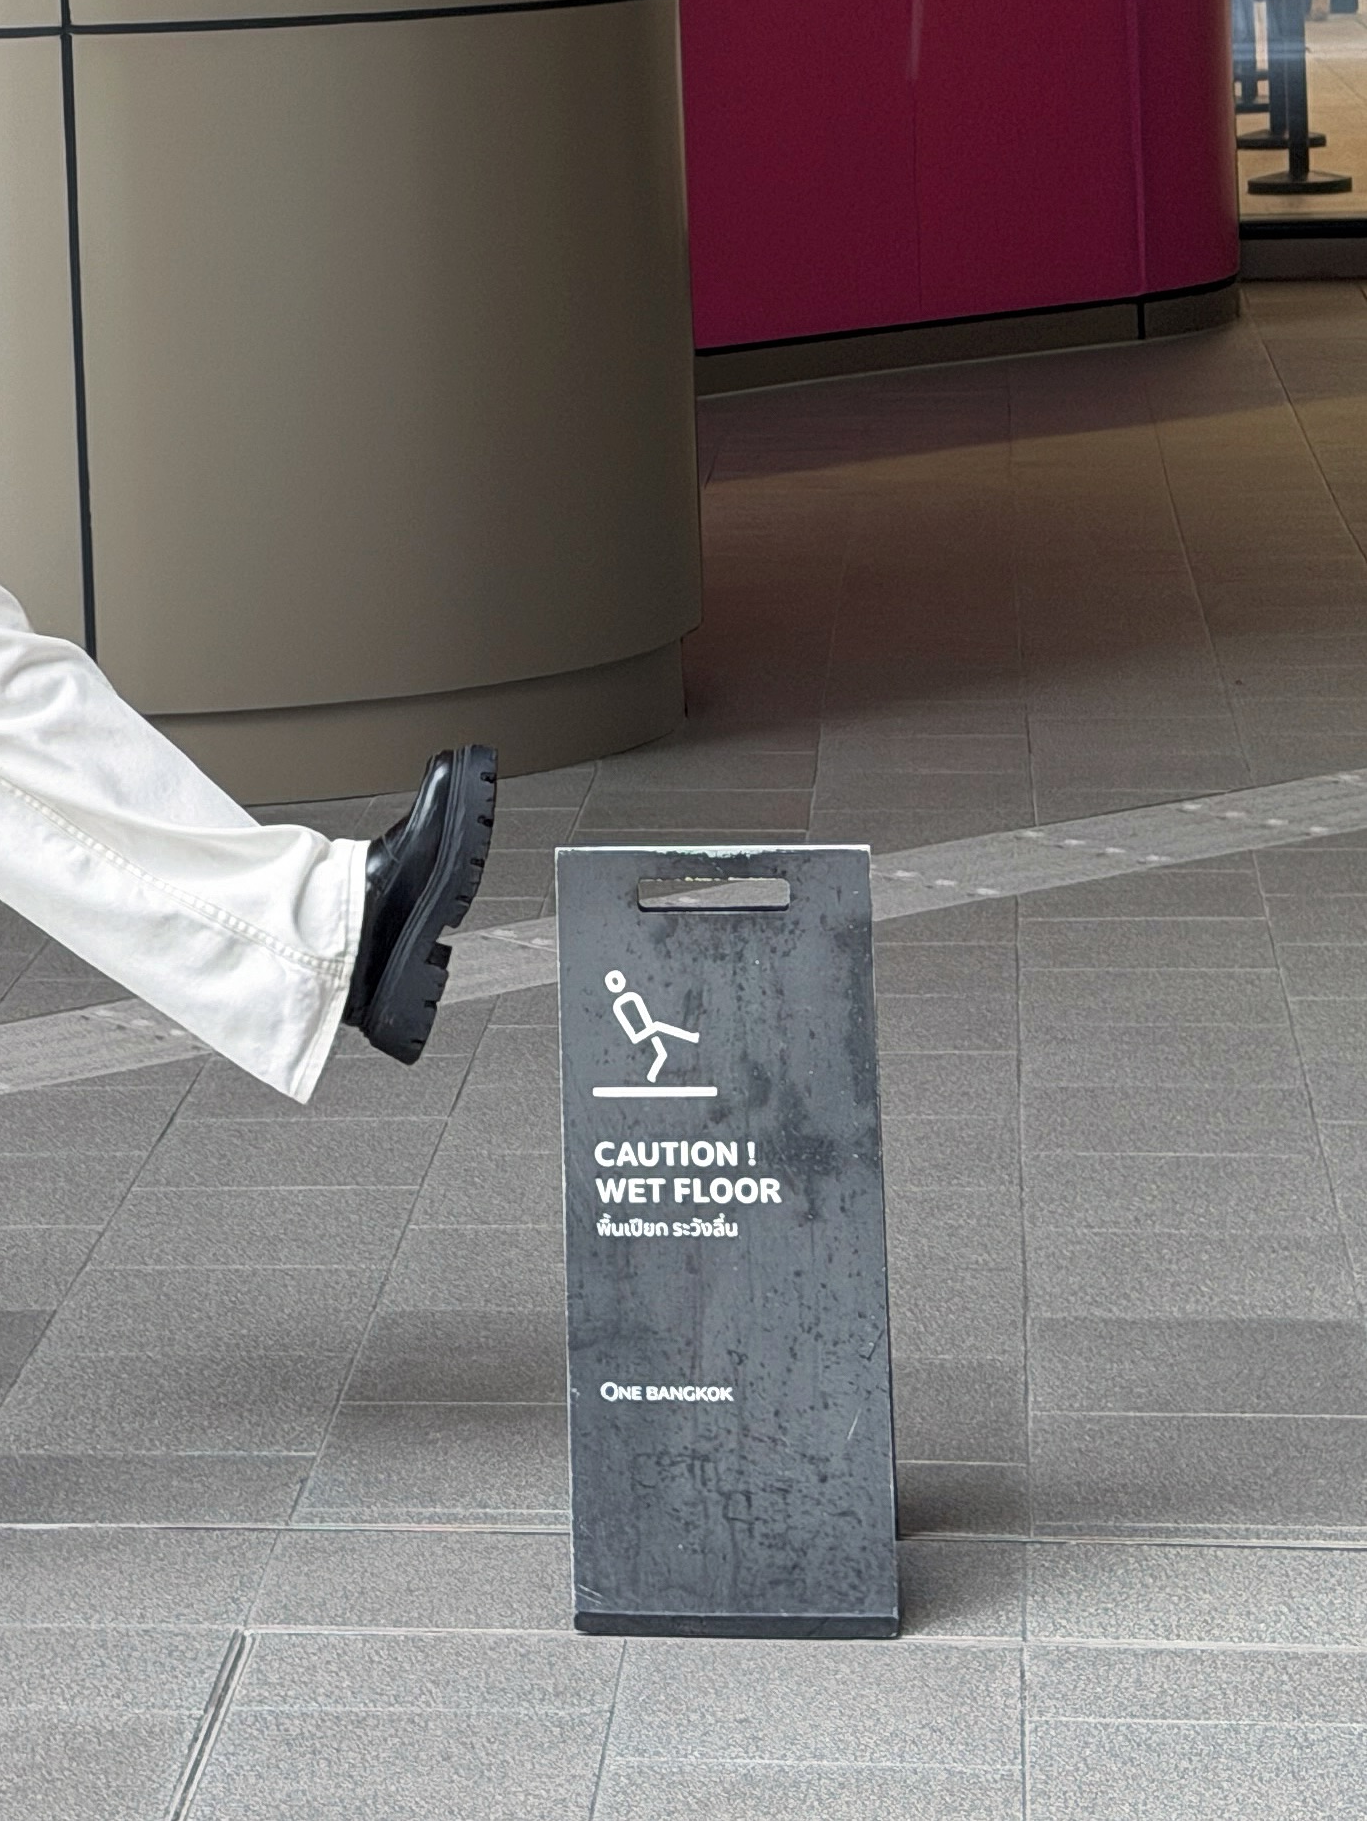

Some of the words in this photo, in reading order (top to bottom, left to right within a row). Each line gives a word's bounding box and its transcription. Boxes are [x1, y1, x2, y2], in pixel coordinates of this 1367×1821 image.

[594, 1141, 738, 1167] CAUTION
[595, 1177, 666, 1204] WET
[673, 1177, 782, 1205] FLOOR
[600, 1381, 643, 1402] ONE
[645, 1385, 734, 1402] BANGKOK
